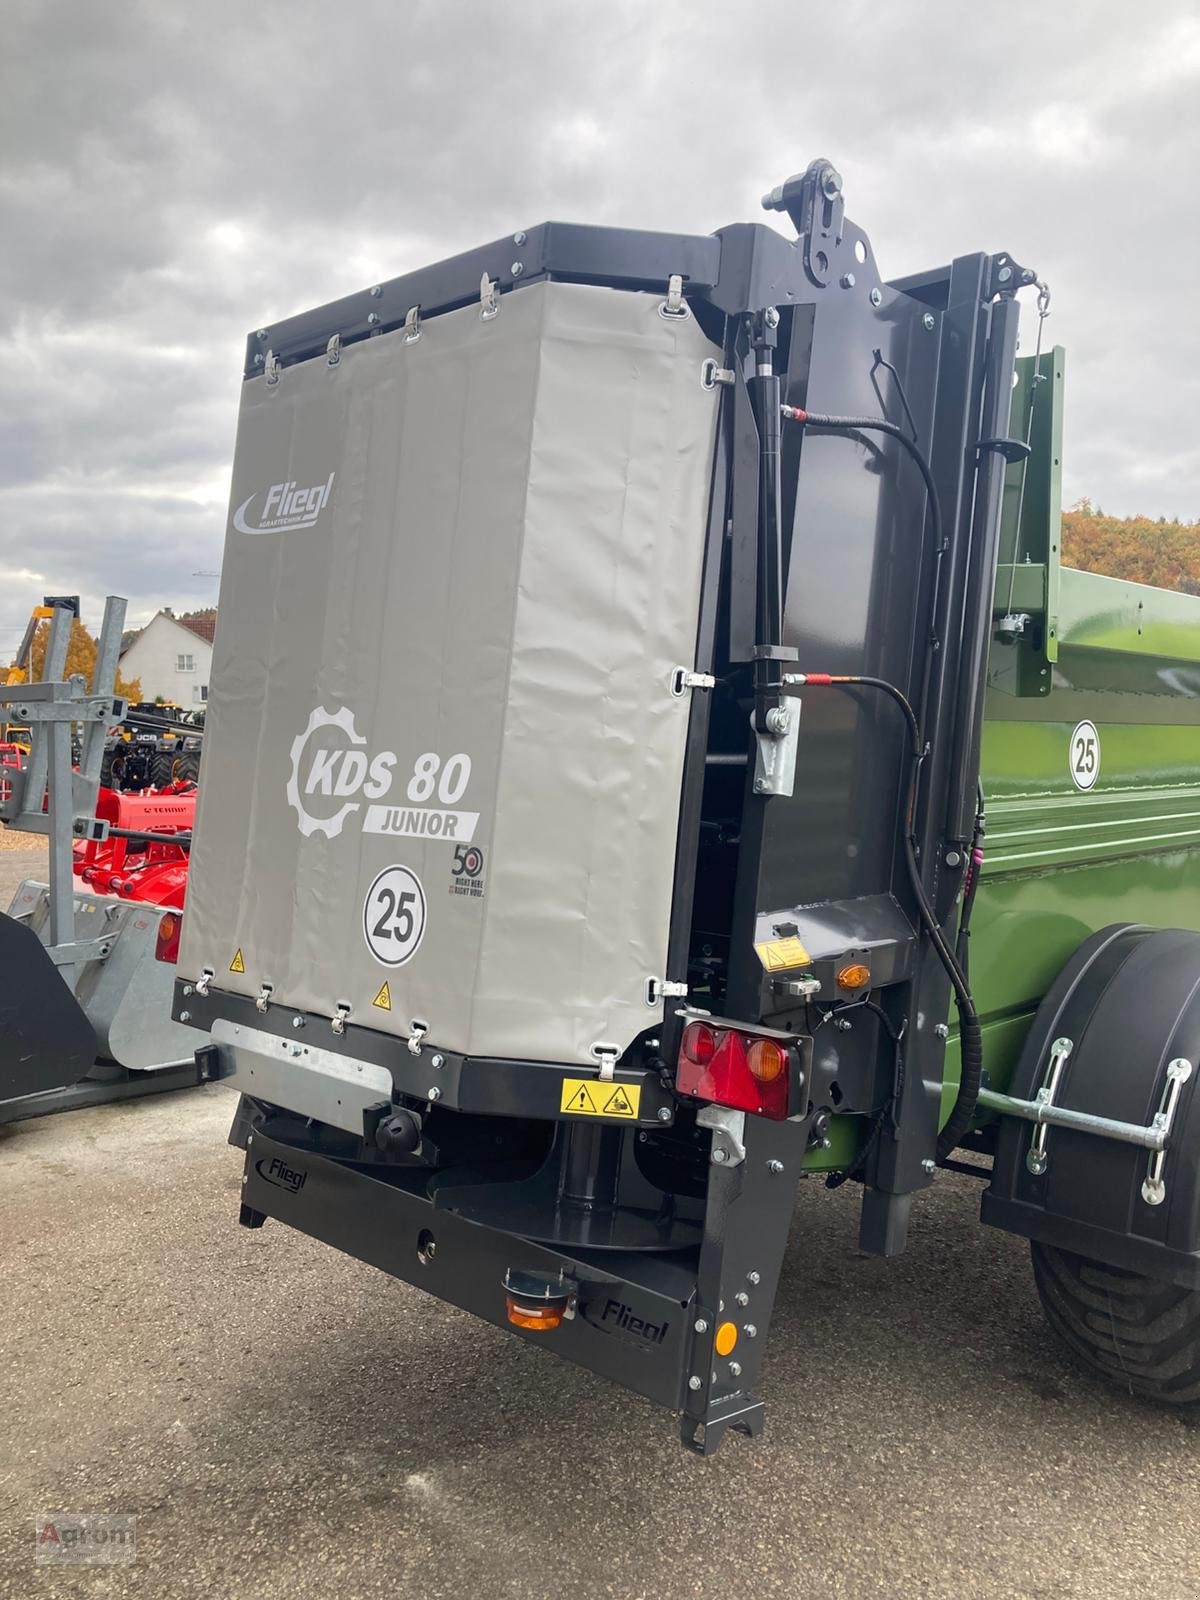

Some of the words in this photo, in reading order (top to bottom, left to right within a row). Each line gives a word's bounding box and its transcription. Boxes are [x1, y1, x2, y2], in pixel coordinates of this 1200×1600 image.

[261, 471, 335, 521] Fliegl
[1075, 737, 1095, 773] 25
[304, 749, 397, 799] KDS
[406, 752, 472, 804] 80
[380, 809, 459, 837] JUNIOR
[451, 844, 484, 877] 50
[454, 885, 469, 896] RIGHT
[455, 877, 470, 887] RIGHT
[372, 888, 416, 943] 25
[269, 1158, 308, 1190] Fliegl
